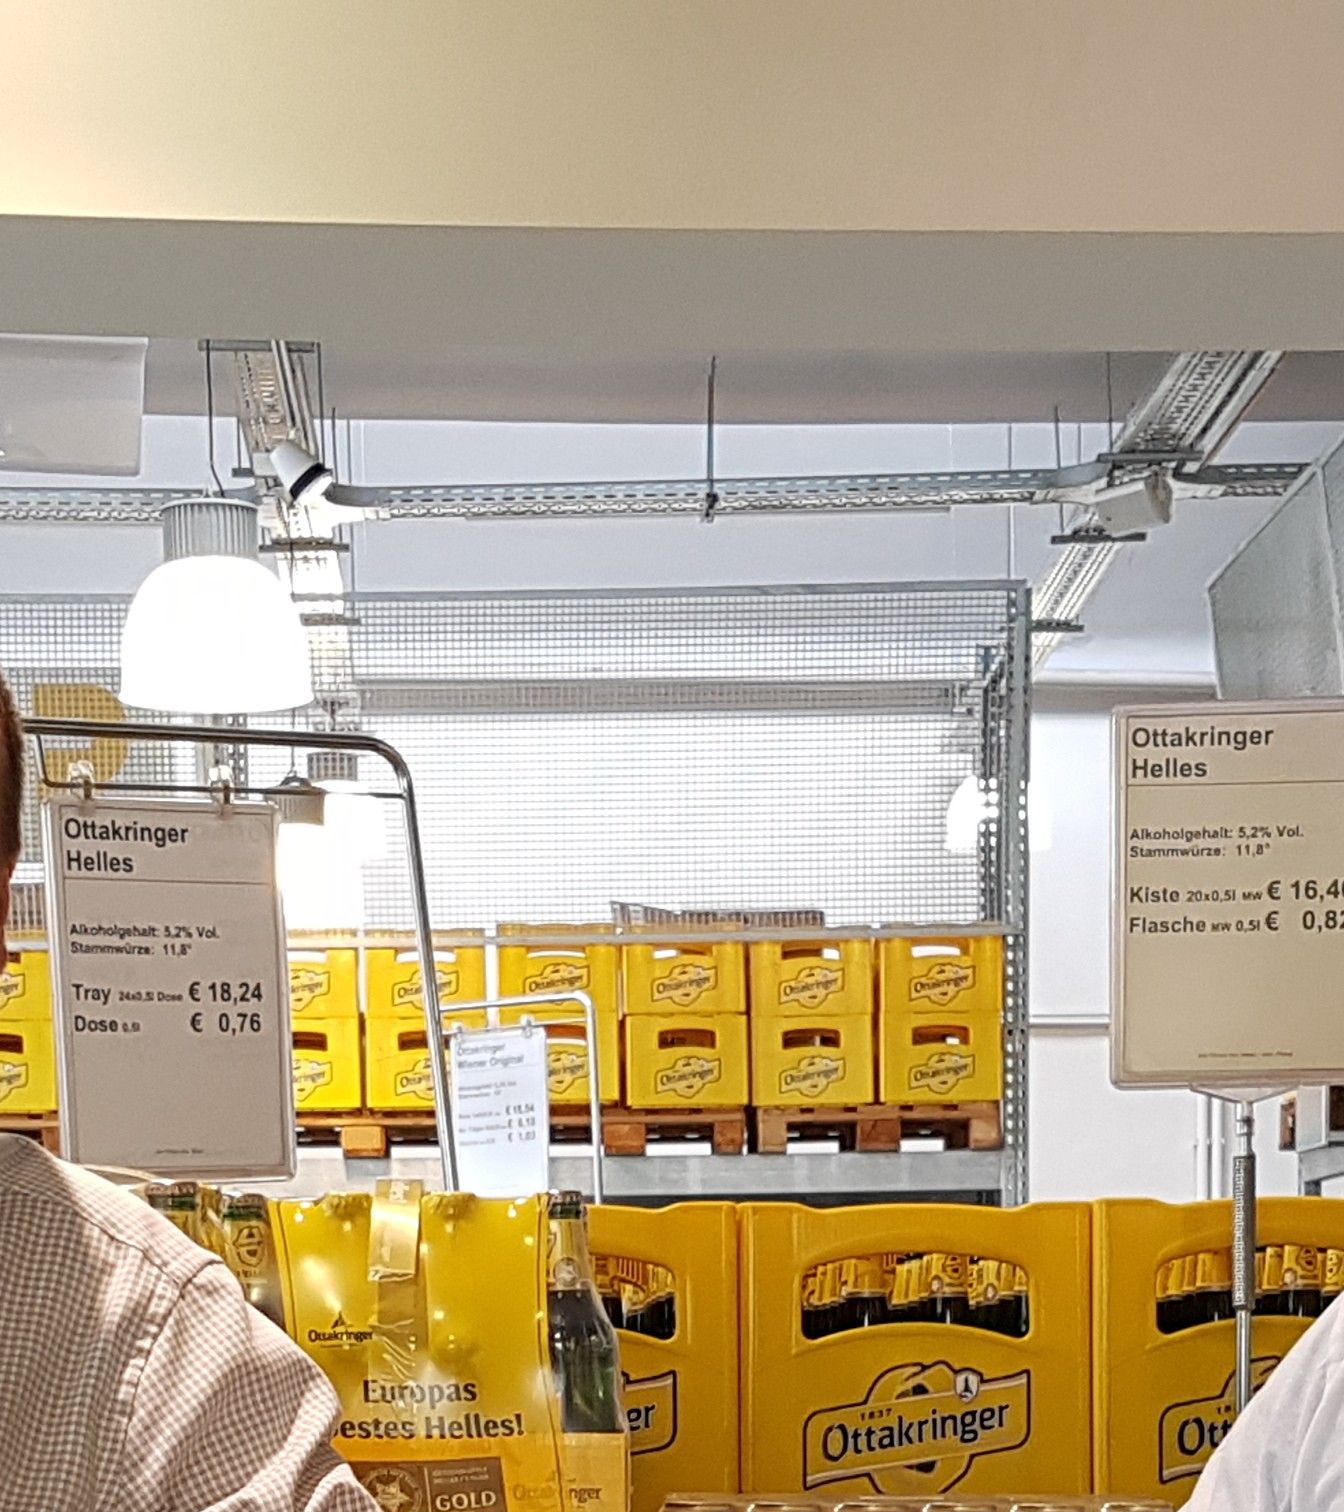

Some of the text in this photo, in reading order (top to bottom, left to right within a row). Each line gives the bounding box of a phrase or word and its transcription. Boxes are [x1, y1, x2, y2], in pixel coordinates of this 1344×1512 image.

[1131, 725, 1275, 751] Ottakringer
[1131, 758, 1208, 779] Helles
[64, 818, 189, 848] Ottakringer
[1129, 825, 1304, 842] Alkoholgehalt: 5,2% Vol.
[66, 850, 134, 872] Helles
[1129, 845, 1226, 858] Stammwürze:
[1129, 886, 1180, 903] Kiste
[1267, 880, 1281, 900] €
[70, 924, 159, 940] Alkoholgehalt:
[196, 926, 220, 939] Vol.
[1129, 916, 1206, 934] Flasche
[1264, 910, 1279, 931] €
[70, 942, 155, 955] Stammwürze:
[72, 983, 111, 1005] Tray
[157, 992, 184, 1001] Dose
[189, 982, 201, 1001] €
[208, 982, 263, 1006] 18,24
[74, 1015, 118, 1032] Dose
[190, 1012, 204, 1033] €
[219, 1013, 261, 1035] 0,76
[308, 1329, 373, 1343] Ottakringer
[363, 1379, 477, 1408] Europas
[425, 1413, 524, 1439] Helles!
[822, 1404, 1009, 1462] Ottakringer
[435, 1491, 496, 1512] GOLD
